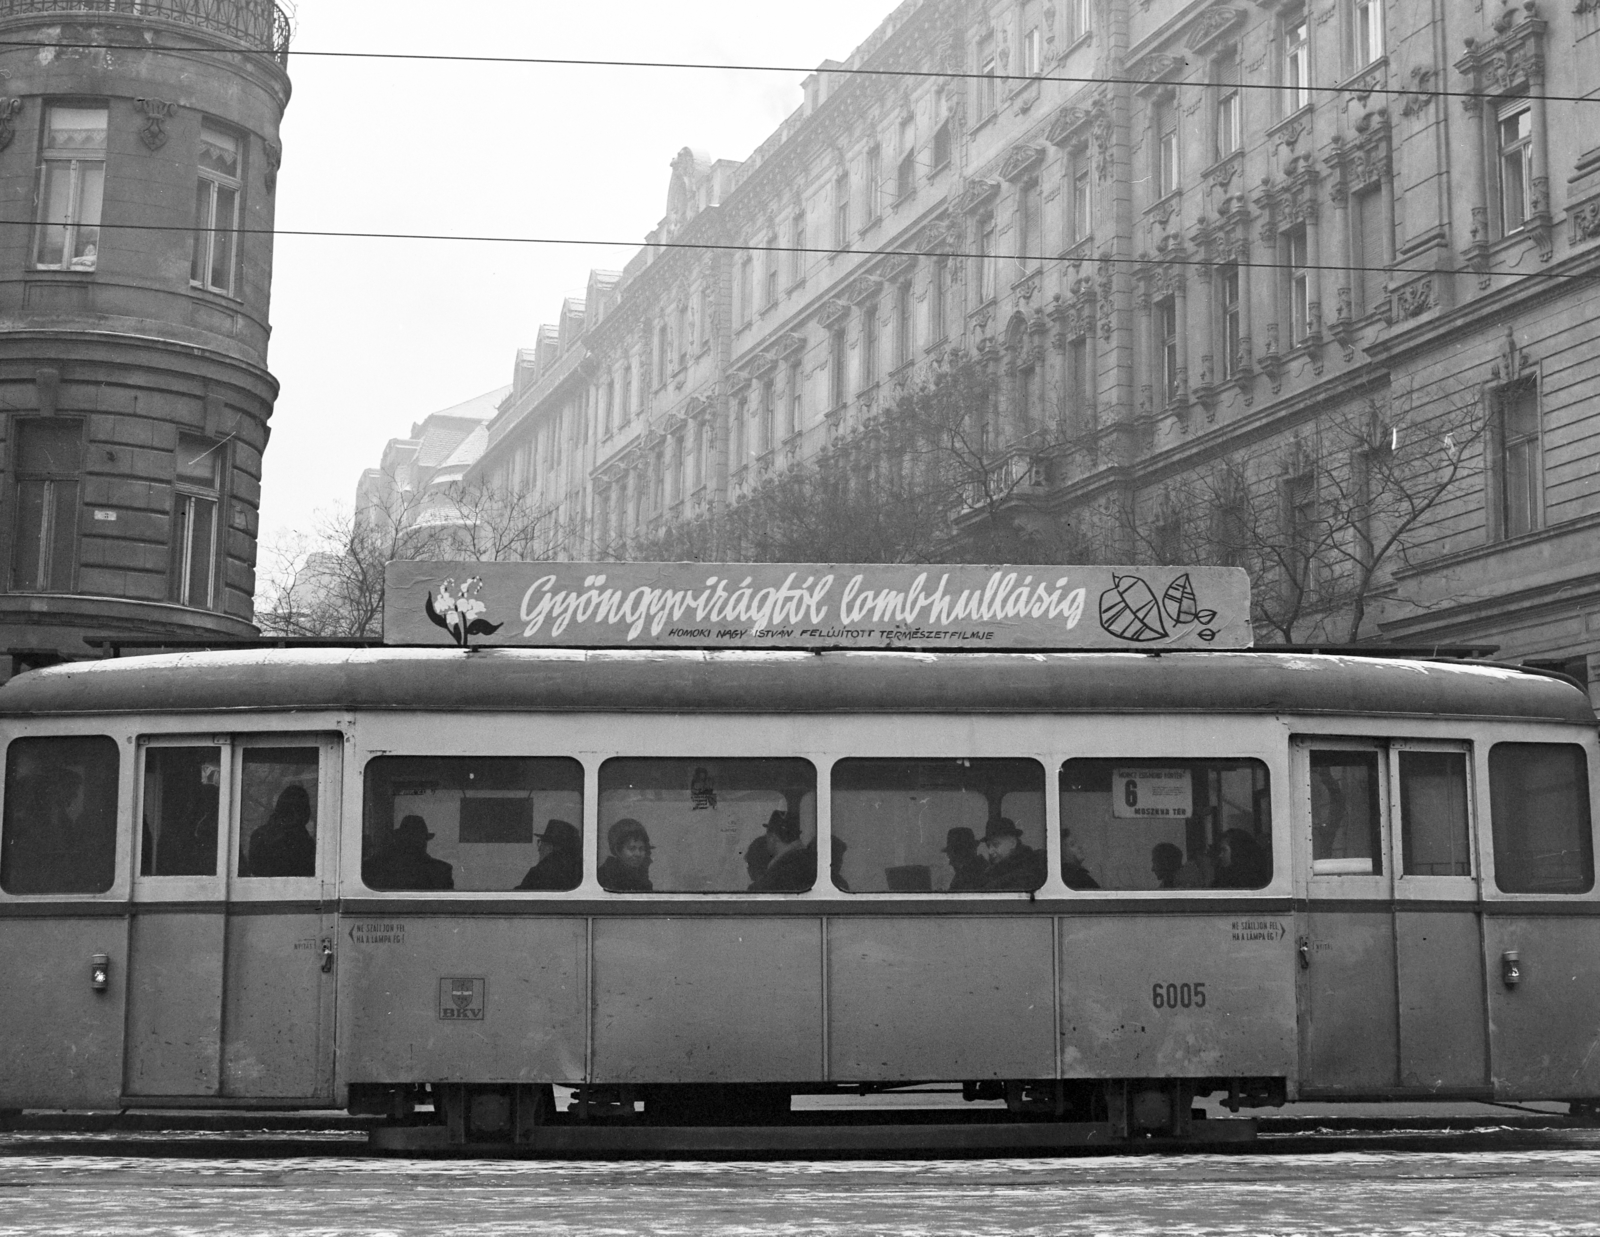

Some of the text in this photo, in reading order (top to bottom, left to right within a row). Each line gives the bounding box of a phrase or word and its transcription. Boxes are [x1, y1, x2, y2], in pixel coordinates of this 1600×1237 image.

[520, 572, 1086, 641] Gyöngyvirágtól lombhullásig
[668, 628, 711, 638] HOMOKI
[716, 629, 748, 639] NAGY
[754, 626, 794, 638] ISTVÁN
[1125, 779, 1138, 807] 6
[1134, 808, 1170, 816] MOSZKVA
[1231, 921, 1239, 931] NE
[1232, 932, 1240, 941] HA
[1152, 982, 1206, 1009] 6005
[442, 1008, 482, 1018] BKV
